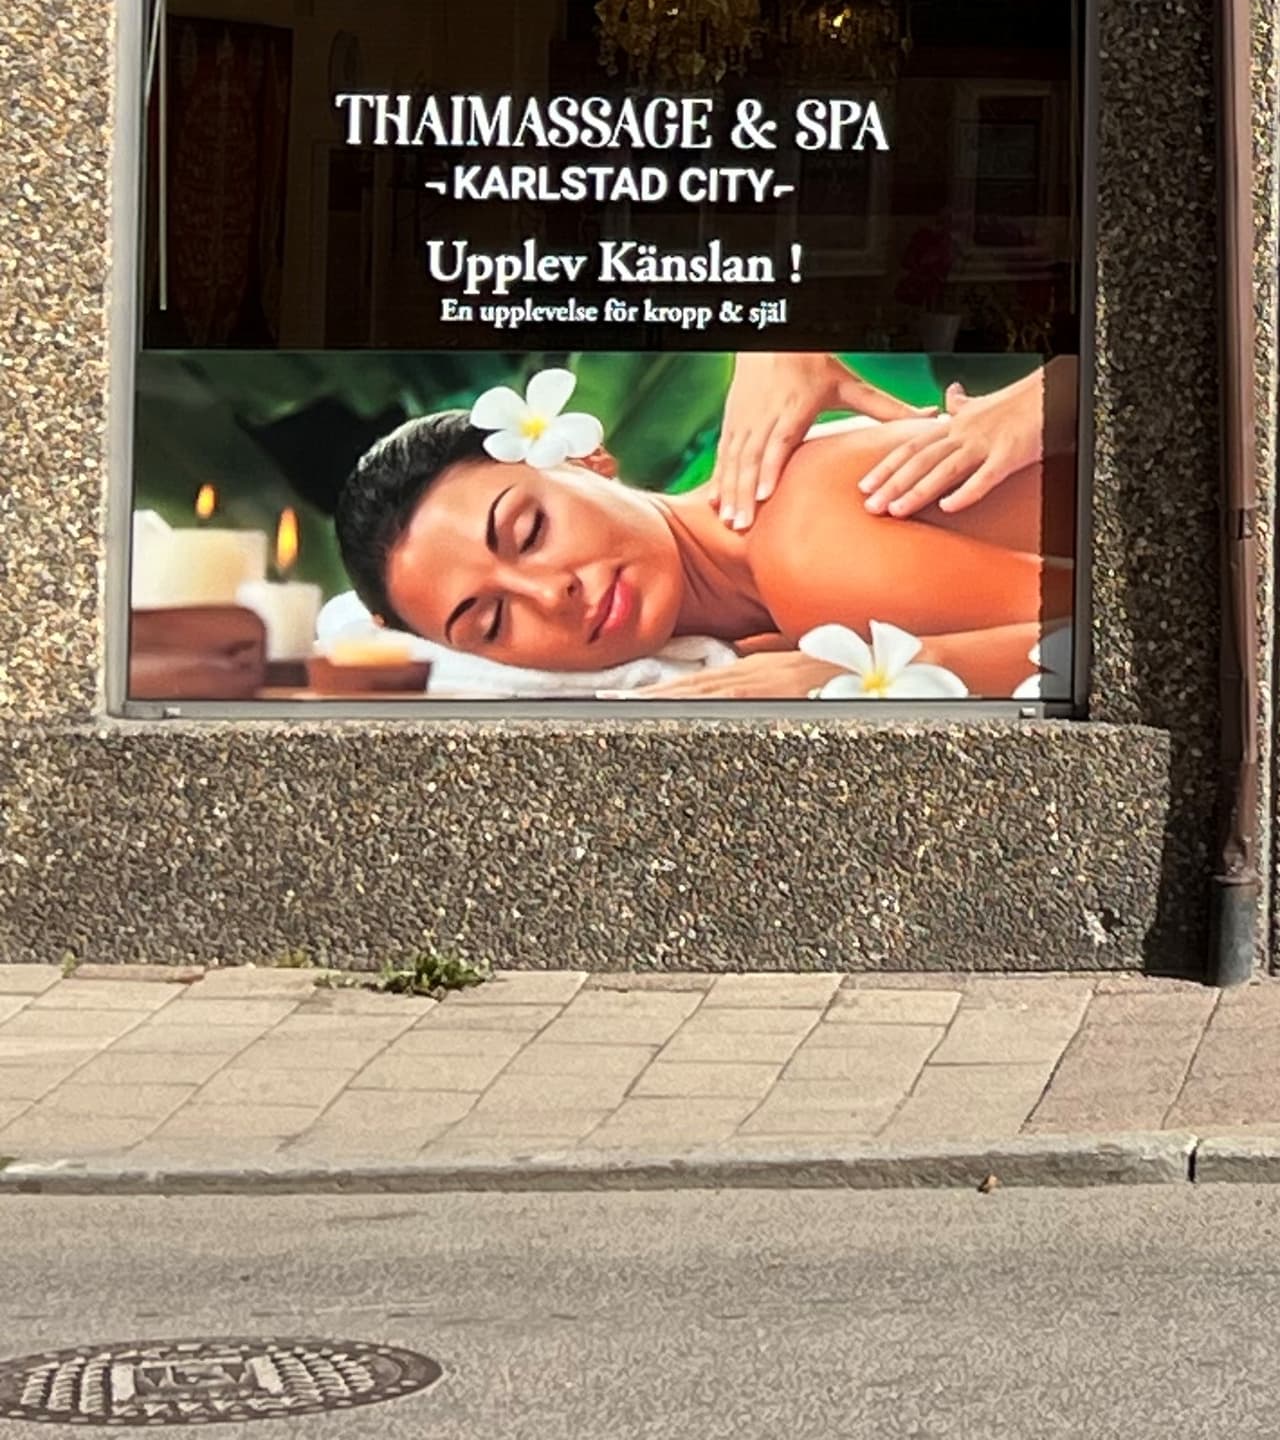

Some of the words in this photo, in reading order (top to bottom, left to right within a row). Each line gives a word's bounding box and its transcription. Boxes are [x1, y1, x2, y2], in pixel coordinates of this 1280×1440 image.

[335, 94, 712, 149] THAIMASSAGE
[731, 98, 777, 150] &
[795, 99, 890, 151] SPA
[427, 240, 587, 294] Upplev
[598, 241, 775, 282] Känslan
[440, 300, 473, 322] En
[480, 300, 598, 329] upplevelse
[604, 298, 638, 322] för
[644, 300, 712, 329] kropp
[720, 301, 744, 323] &
[749, 300, 787, 330] själ
